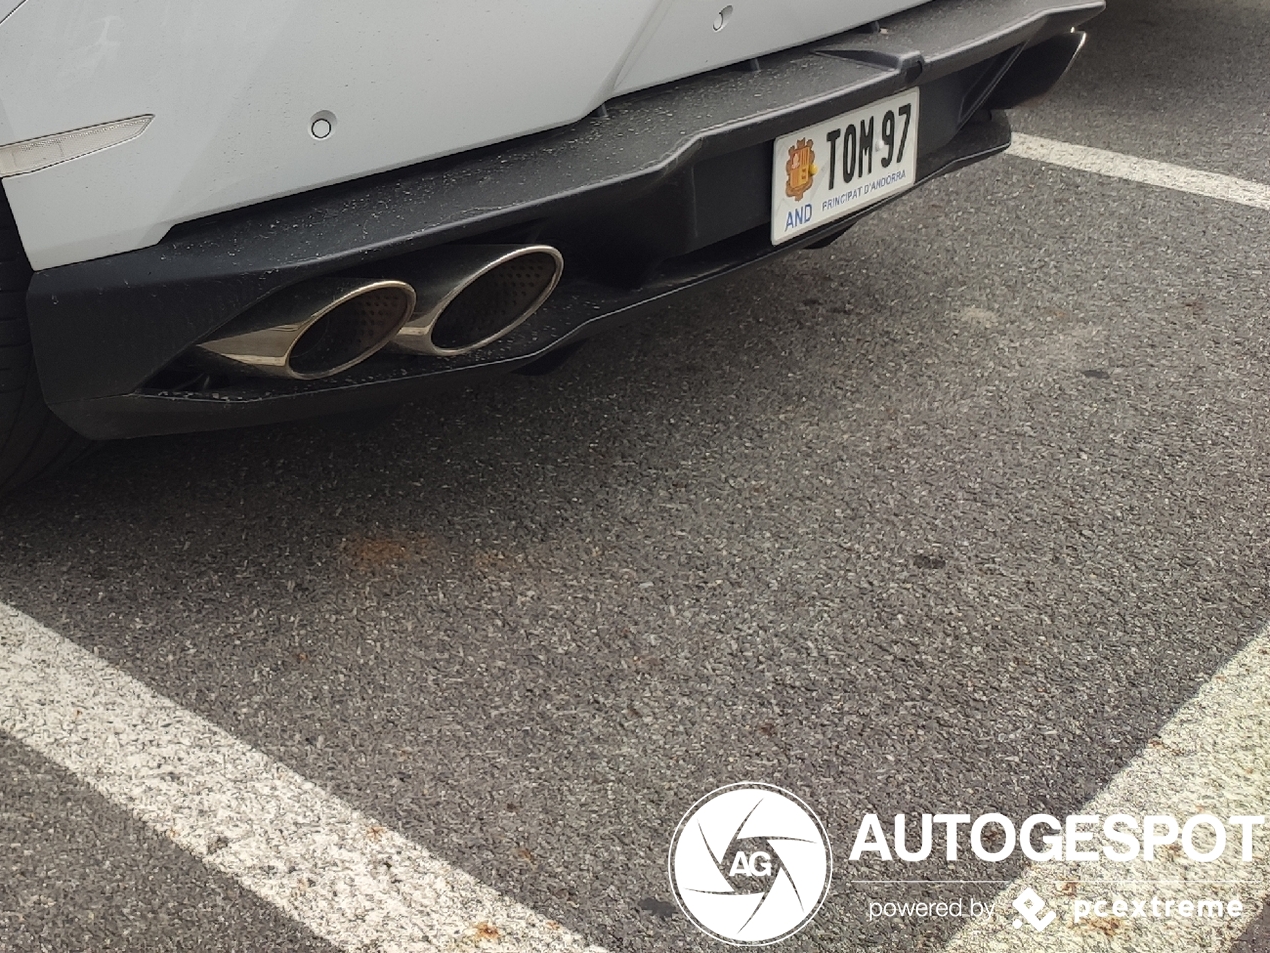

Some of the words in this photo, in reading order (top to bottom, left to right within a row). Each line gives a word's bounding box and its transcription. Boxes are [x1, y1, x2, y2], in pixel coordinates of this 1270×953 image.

[826, 115, 875, 191] TOM
[881, 103, 912, 168] 97
[784, 203, 813, 232] AND
[821, 188, 863, 213] PRINCIPAT
[864, 169, 907, 195] D'ANDORRA
